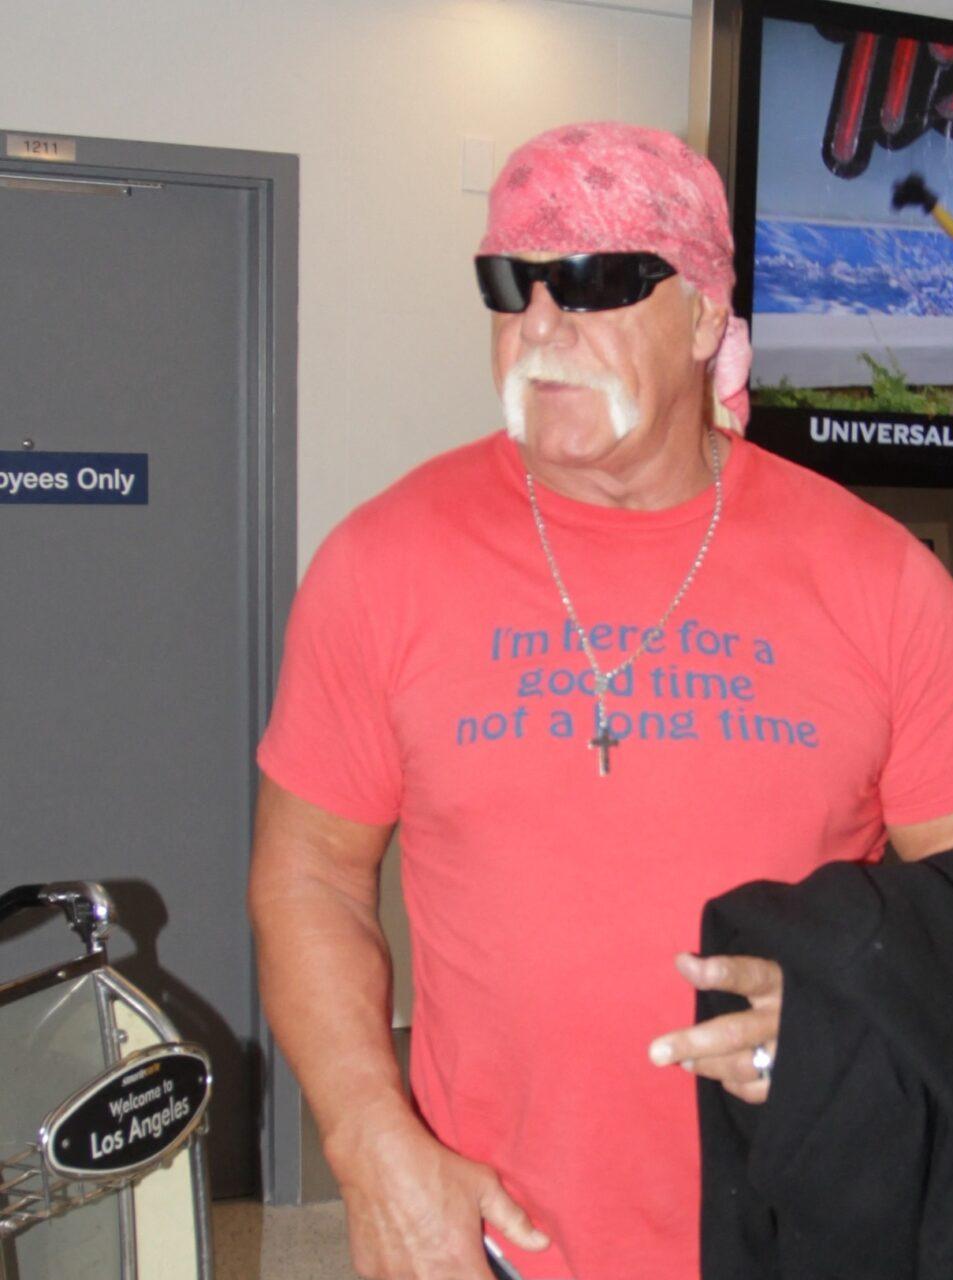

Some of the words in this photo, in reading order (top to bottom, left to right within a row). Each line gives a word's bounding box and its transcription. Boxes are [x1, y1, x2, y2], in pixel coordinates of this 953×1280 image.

[24, 140, 58, 155] 1211
[77, 467, 135, 495] Only
[491, 626, 550, 661] I'm
[563, 618, 667, 655] here
[677, 619, 741, 657] for
[753, 637, 776, 665] a
[517, 664, 635, 698] good
[649, 665, 756, 702] time
[456, 706, 529, 746] not
[549, 709, 574, 738] a
[717, 707, 820, 749] time
[109, 1090, 161, 1122] Welcome
[162, 1079, 174, 1094] to
[90, 1130, 124, 1160] Los
[128, 1096, 189, 1143] Angeles
